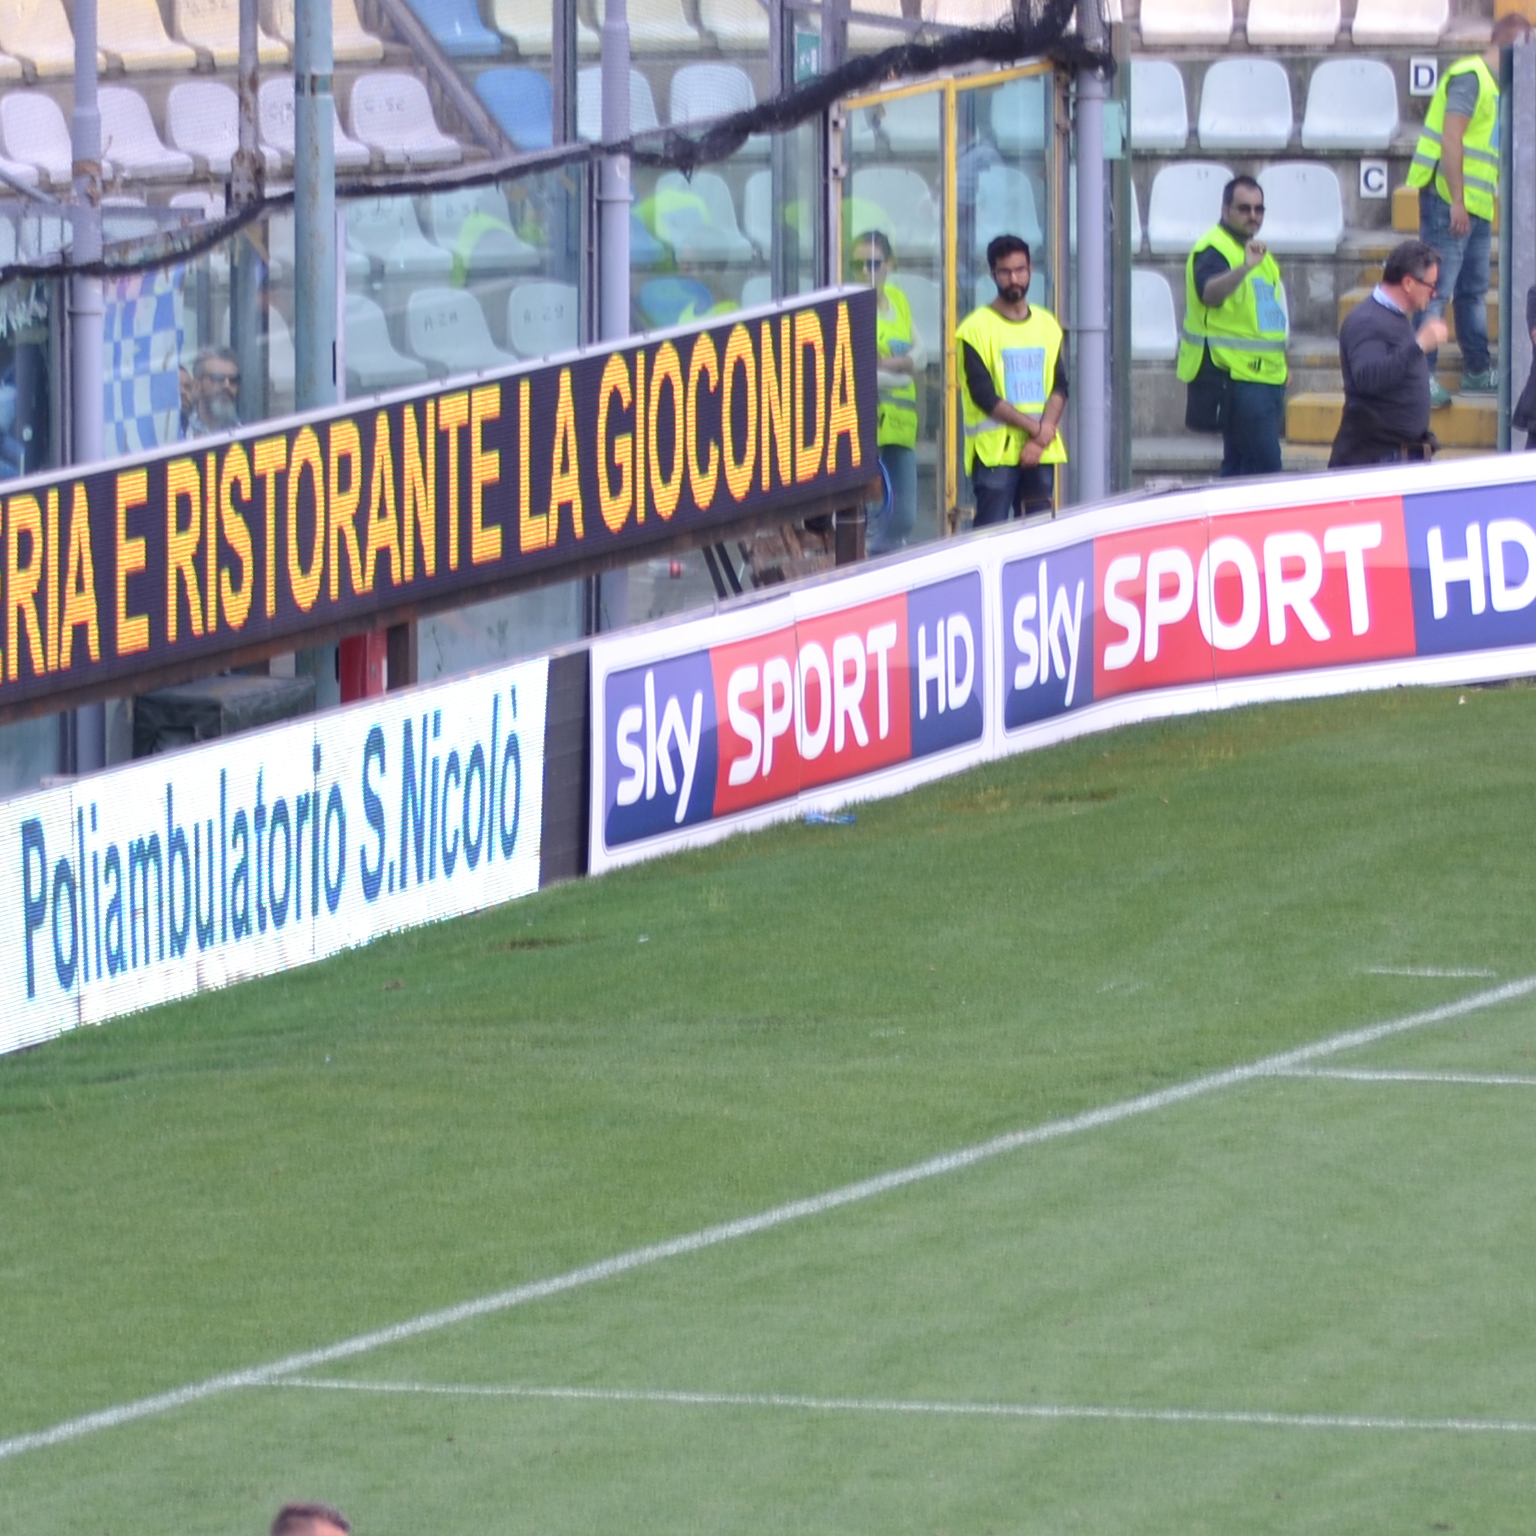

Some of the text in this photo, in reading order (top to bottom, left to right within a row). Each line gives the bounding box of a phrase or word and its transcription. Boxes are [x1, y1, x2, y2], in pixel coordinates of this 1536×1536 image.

[1413, 63, 1436, 90] D
[1363, 167, 1383, 193] C
[115, 467, 149, 655] E
[166, 384, 502, 643] RISTORANTE
[519, 366, 584, 553] LA
[596, 300, 861, 534] GIOCONDA
[1013, 559, 1085, 708] sky
[1102, 522, 1383, 671] SPORT
[615, 611, 976, 824] sky SPORT HD
[21, 684, 522, 1000] Poliambulatorio S.Nicolò
